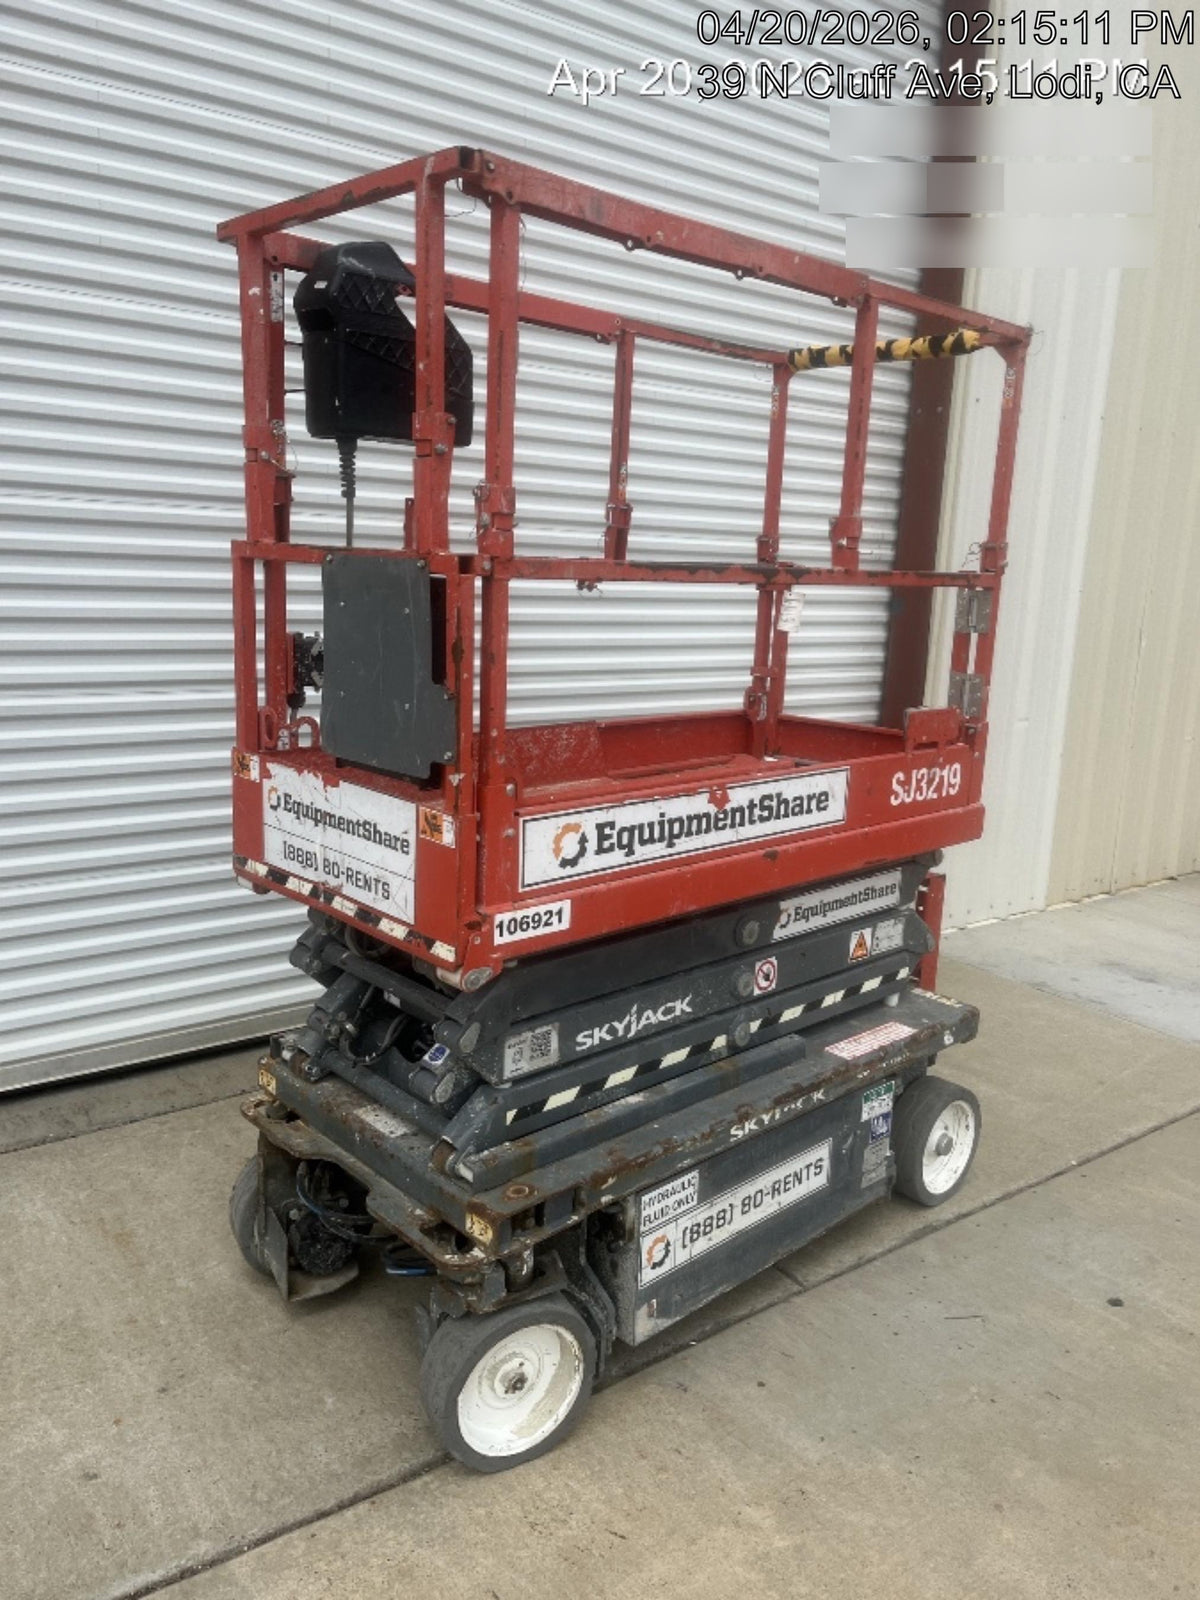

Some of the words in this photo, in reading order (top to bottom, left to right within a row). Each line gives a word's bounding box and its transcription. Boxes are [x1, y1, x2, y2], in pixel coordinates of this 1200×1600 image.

[890, 762, 961, 806] SJ3219
[282, 792, 411, 856] EquipmentShare
[593, 789, 831, 858] EquipmentShare
[495, 906, 564, 938] 106921
[575, 992, 693, 1052] SKYJACK
